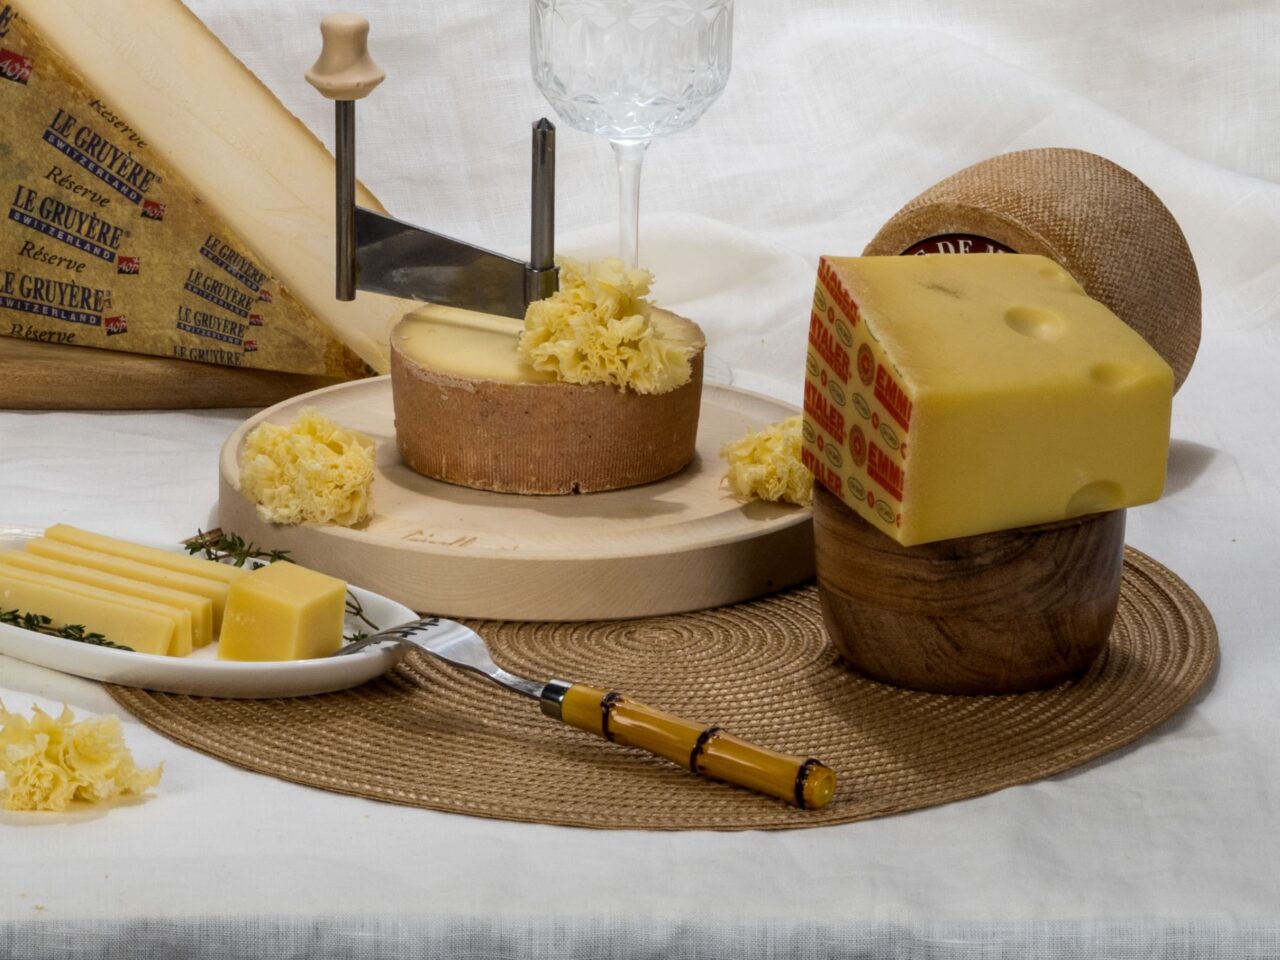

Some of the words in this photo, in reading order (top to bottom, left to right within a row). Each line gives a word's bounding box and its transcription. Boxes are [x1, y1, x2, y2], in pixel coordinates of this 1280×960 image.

[50, 108, 77, 140] LE
[47, 134, 138, 202] SWITZERLAND
[12, 185, 38, 214] LE
[44, 165, 112, 209] Réserve
[13, 211, 111, 260] SWITZERLAND
[204, 232, 222, 252] LE
[19, 240, 87, 273] Réserve
[187, 268, 204, 286] LE
[178, 305, 191, 324] LE
[173, 345, 187, 358] LE
